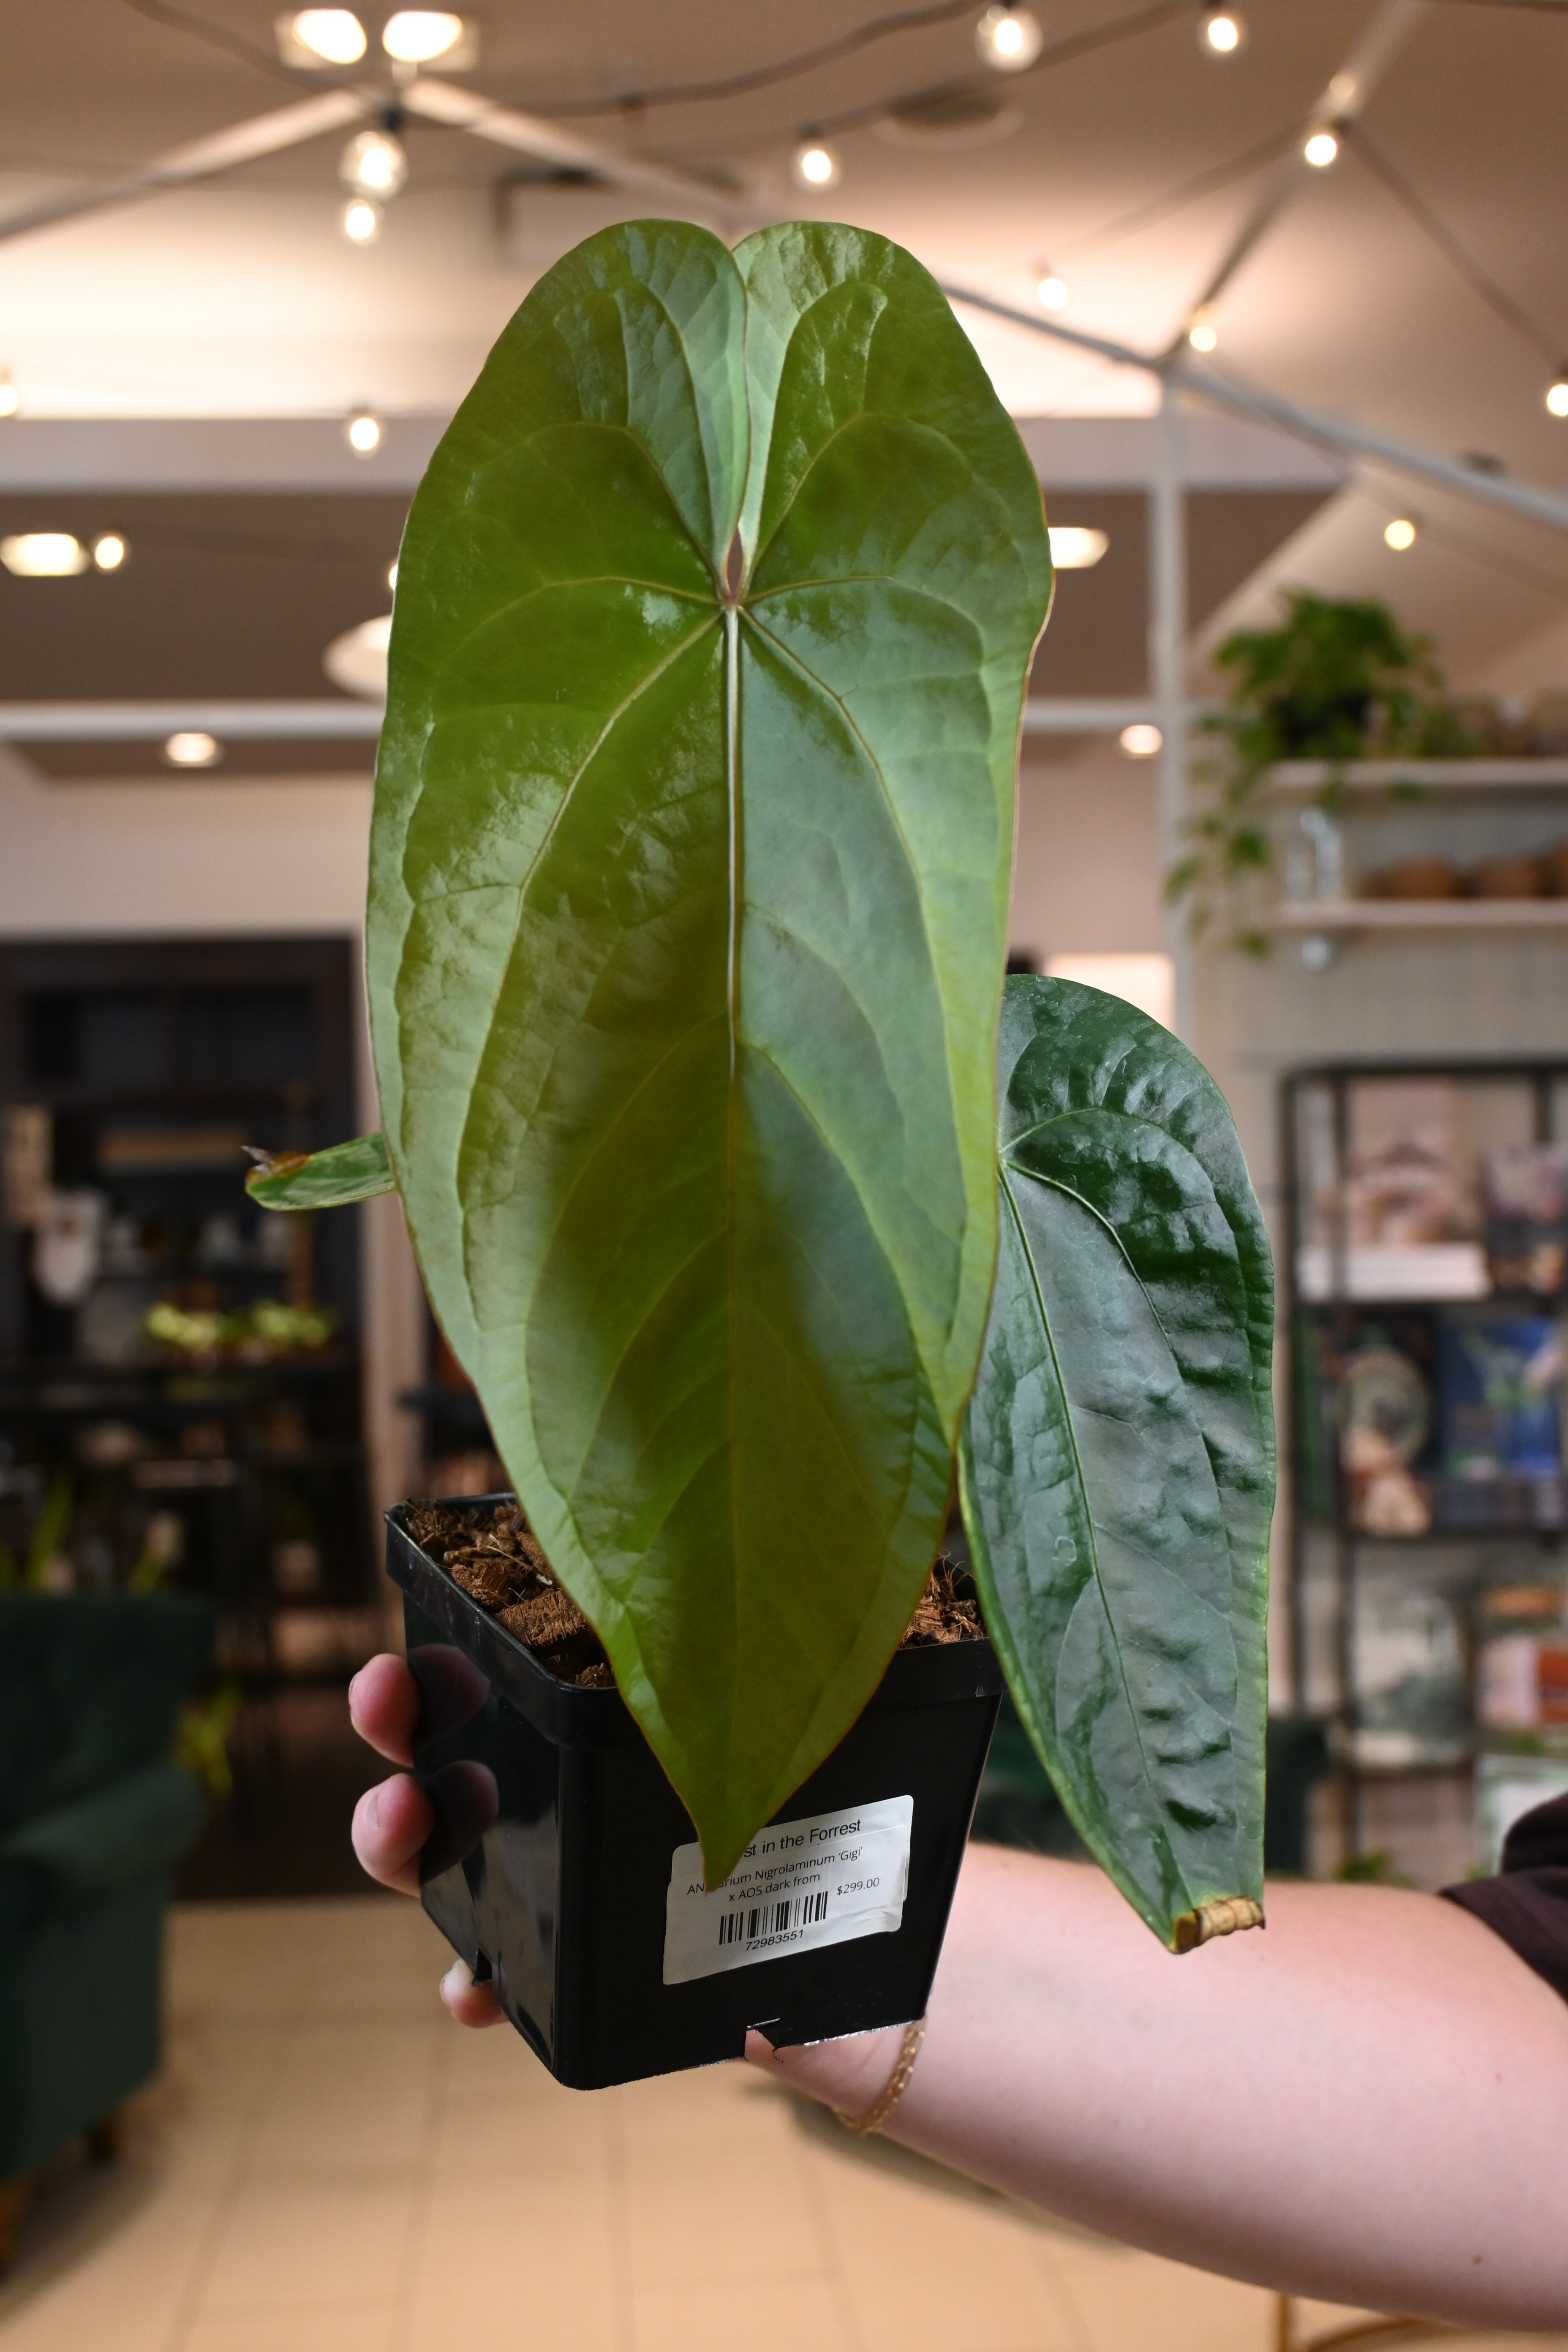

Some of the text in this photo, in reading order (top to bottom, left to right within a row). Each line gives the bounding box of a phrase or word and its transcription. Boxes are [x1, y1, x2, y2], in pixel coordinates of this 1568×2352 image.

[762, 1840, 775, 1854] in
[780, 1835, 804, 1849] the
[809, 1819, 861, 1843] Forrest
[687, 1874, 751, 1895] ANrium
[755, 1854, 835, 1880] Nigrolaminum
[728, 1874, 820, 1902] x AOS dark from
[836, 1877, 880, 1895] $299.00
[746, 1929, 803, 1951] 72983551
